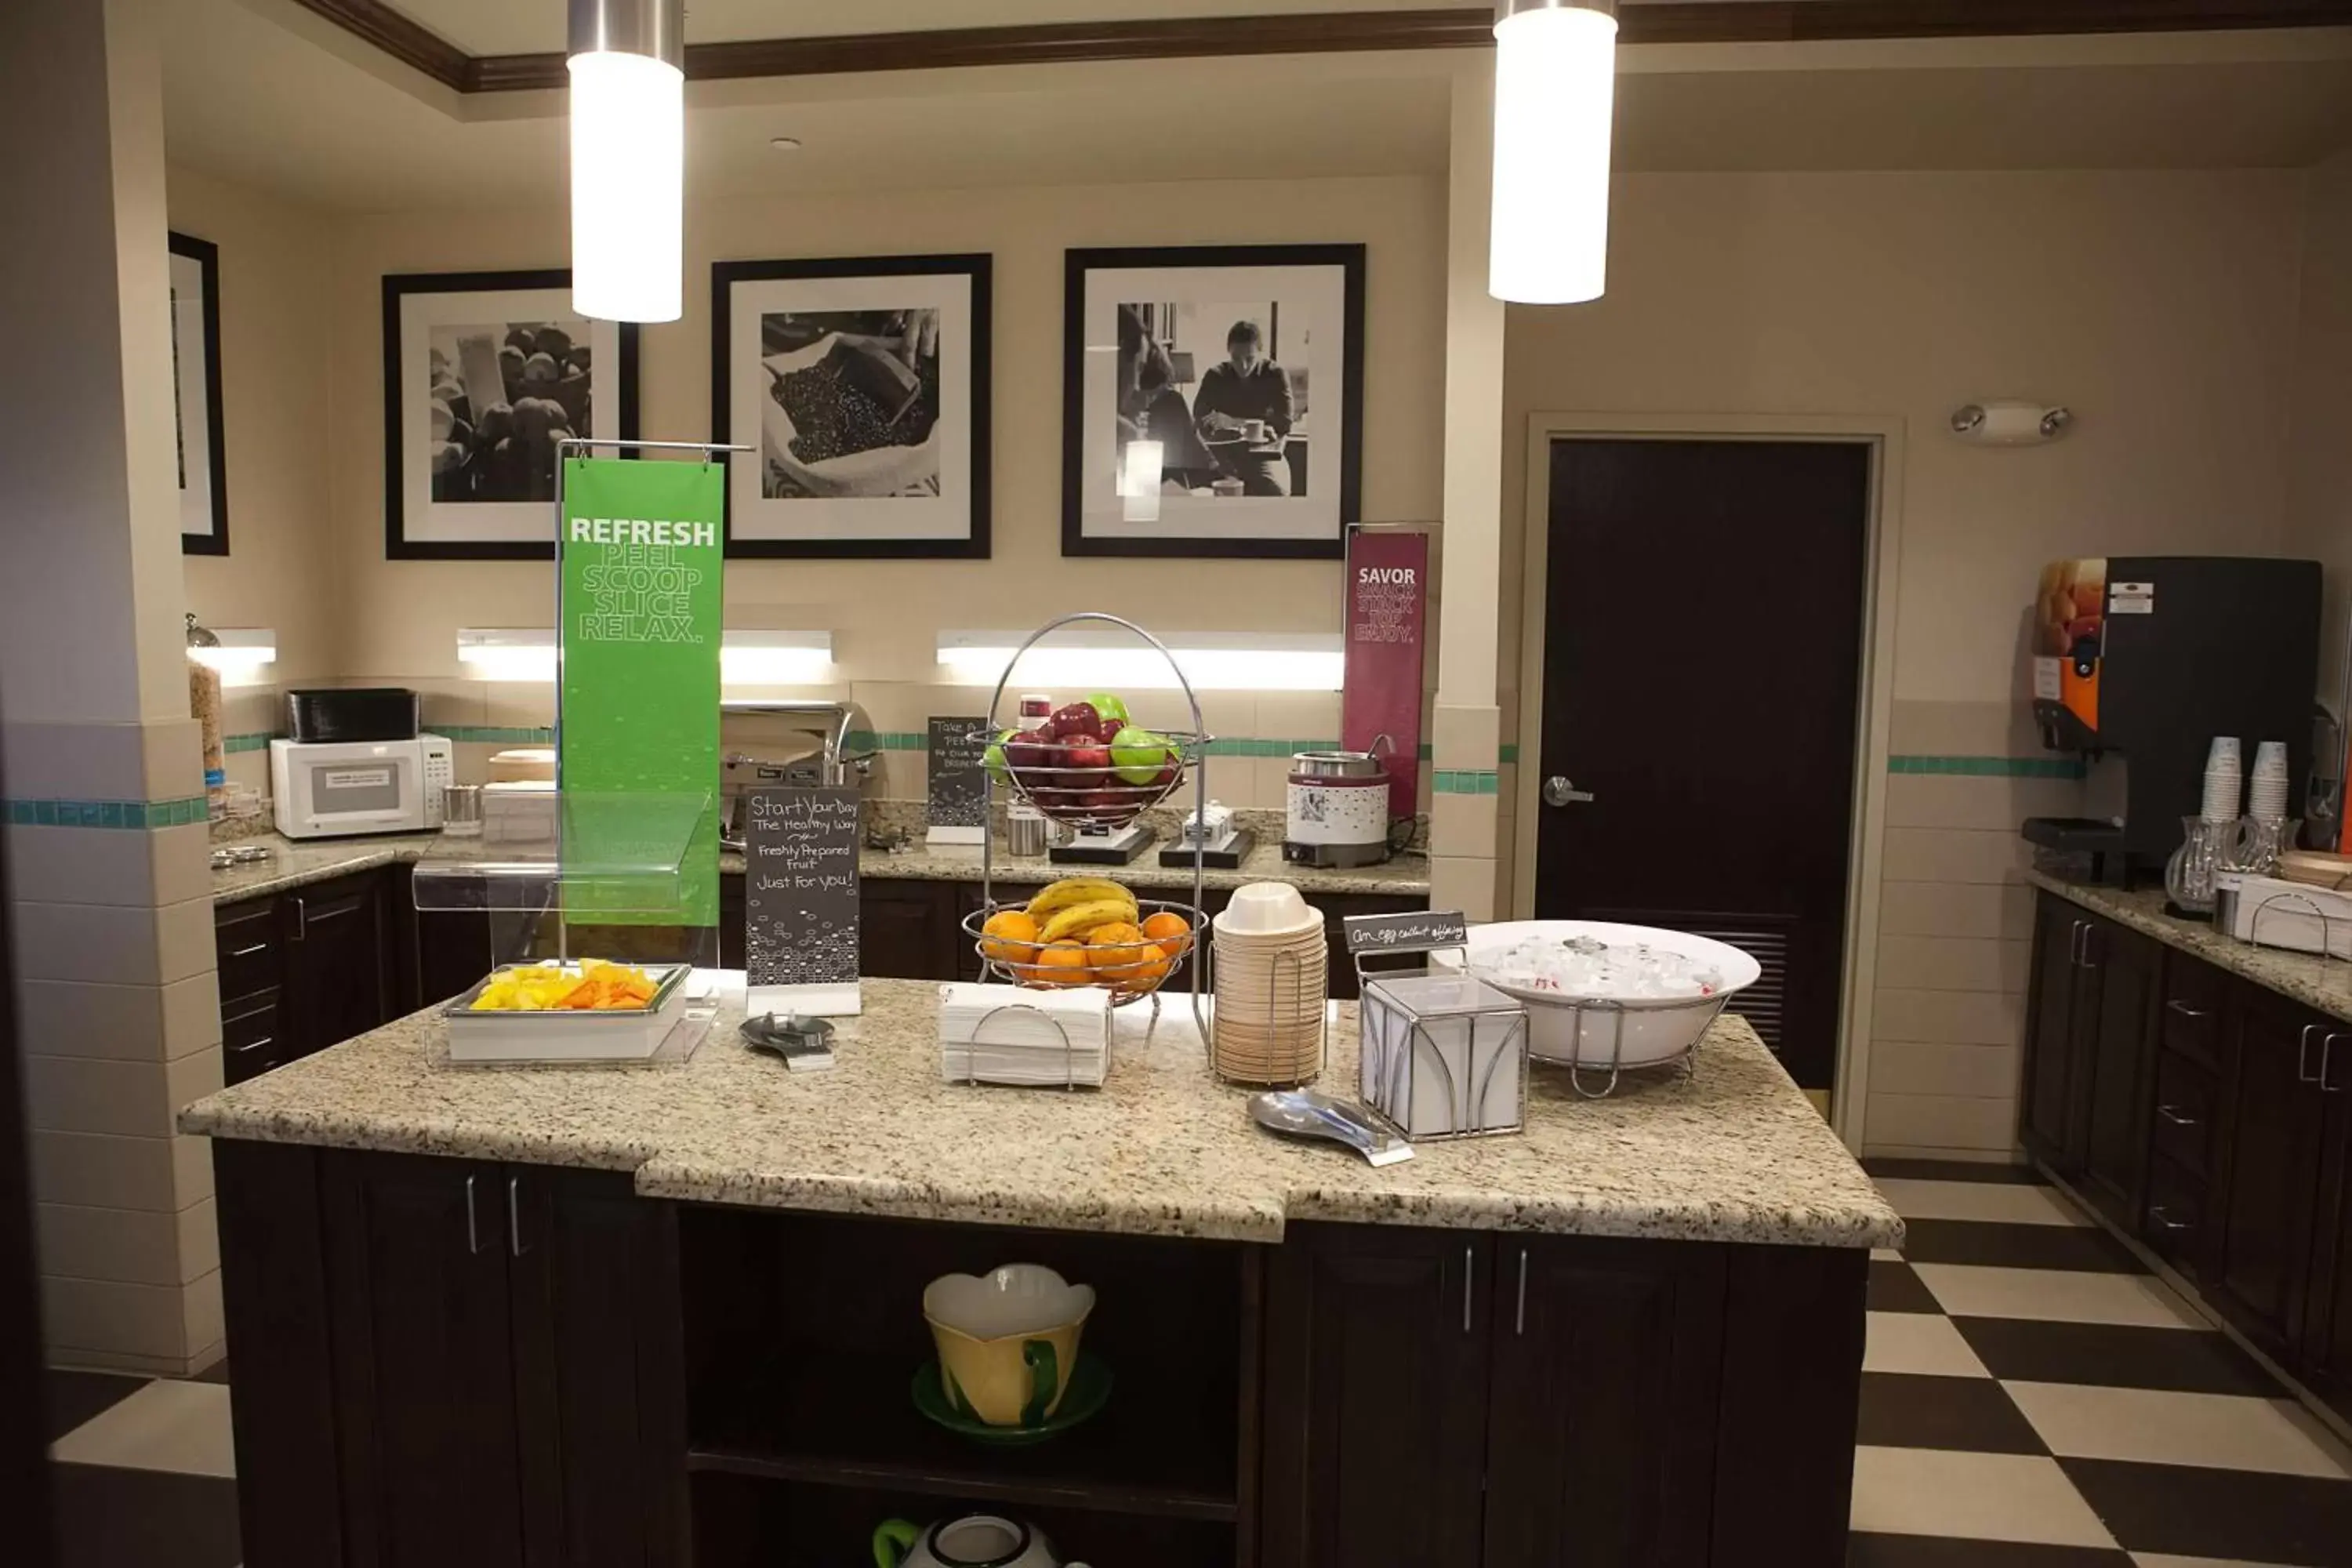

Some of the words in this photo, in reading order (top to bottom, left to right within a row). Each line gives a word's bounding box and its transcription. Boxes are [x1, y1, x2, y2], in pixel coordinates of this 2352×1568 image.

[571, 517, 715, 546] REFRESH
[601, 543, 684, 568] PEEL
[583, 564, 702, 594] SCOOP
[1359, 568, 1415, 584] SAVOR
[593, 590, 691, 618] SLICE
[1357, 597, 1414, 614] STACK
[579, 614, 703, 644] RELAX.
[1368, 610, 1403, 628] TOP
[751, 795, 803, 817] Start
[757, 872, 791, 891] Just
